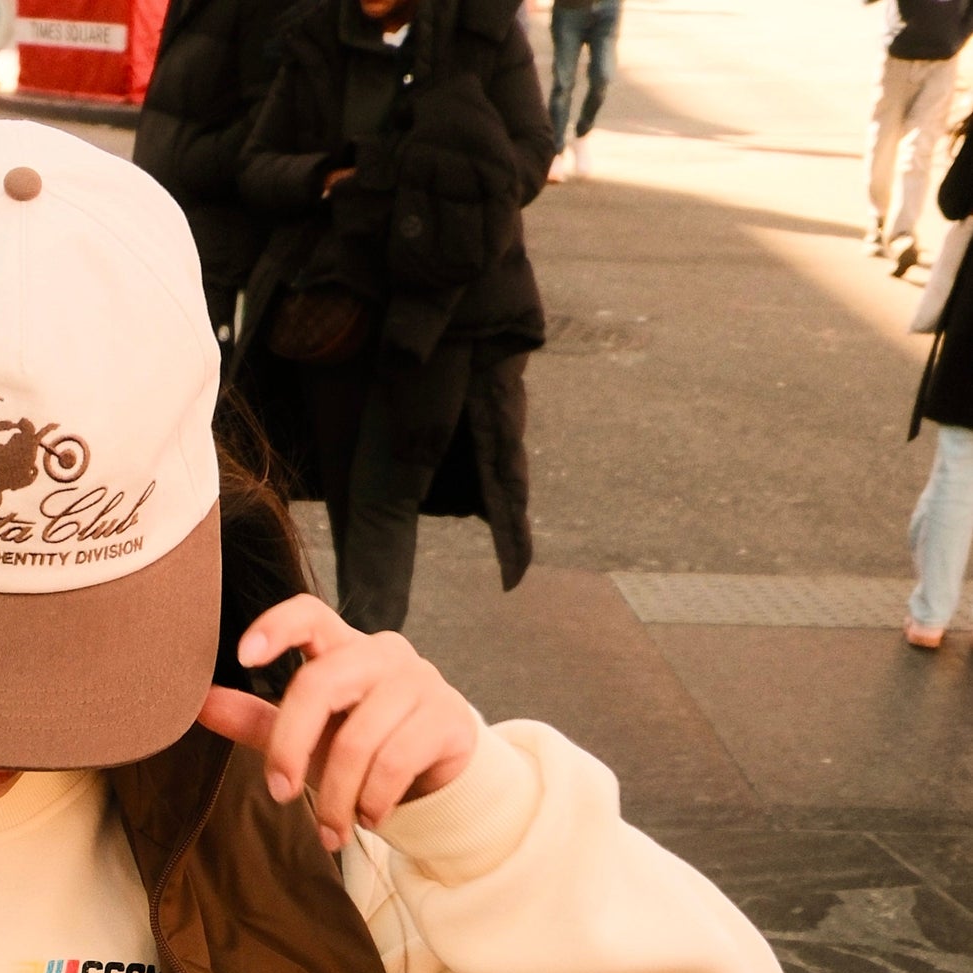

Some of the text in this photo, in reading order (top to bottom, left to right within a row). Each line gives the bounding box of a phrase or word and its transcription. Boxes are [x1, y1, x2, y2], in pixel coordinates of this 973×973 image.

[30, 20, 110, 44] TIMES SQUARE
[40, 480, 156, 543] Club
[75, 536, 145, 565] DIVISION
